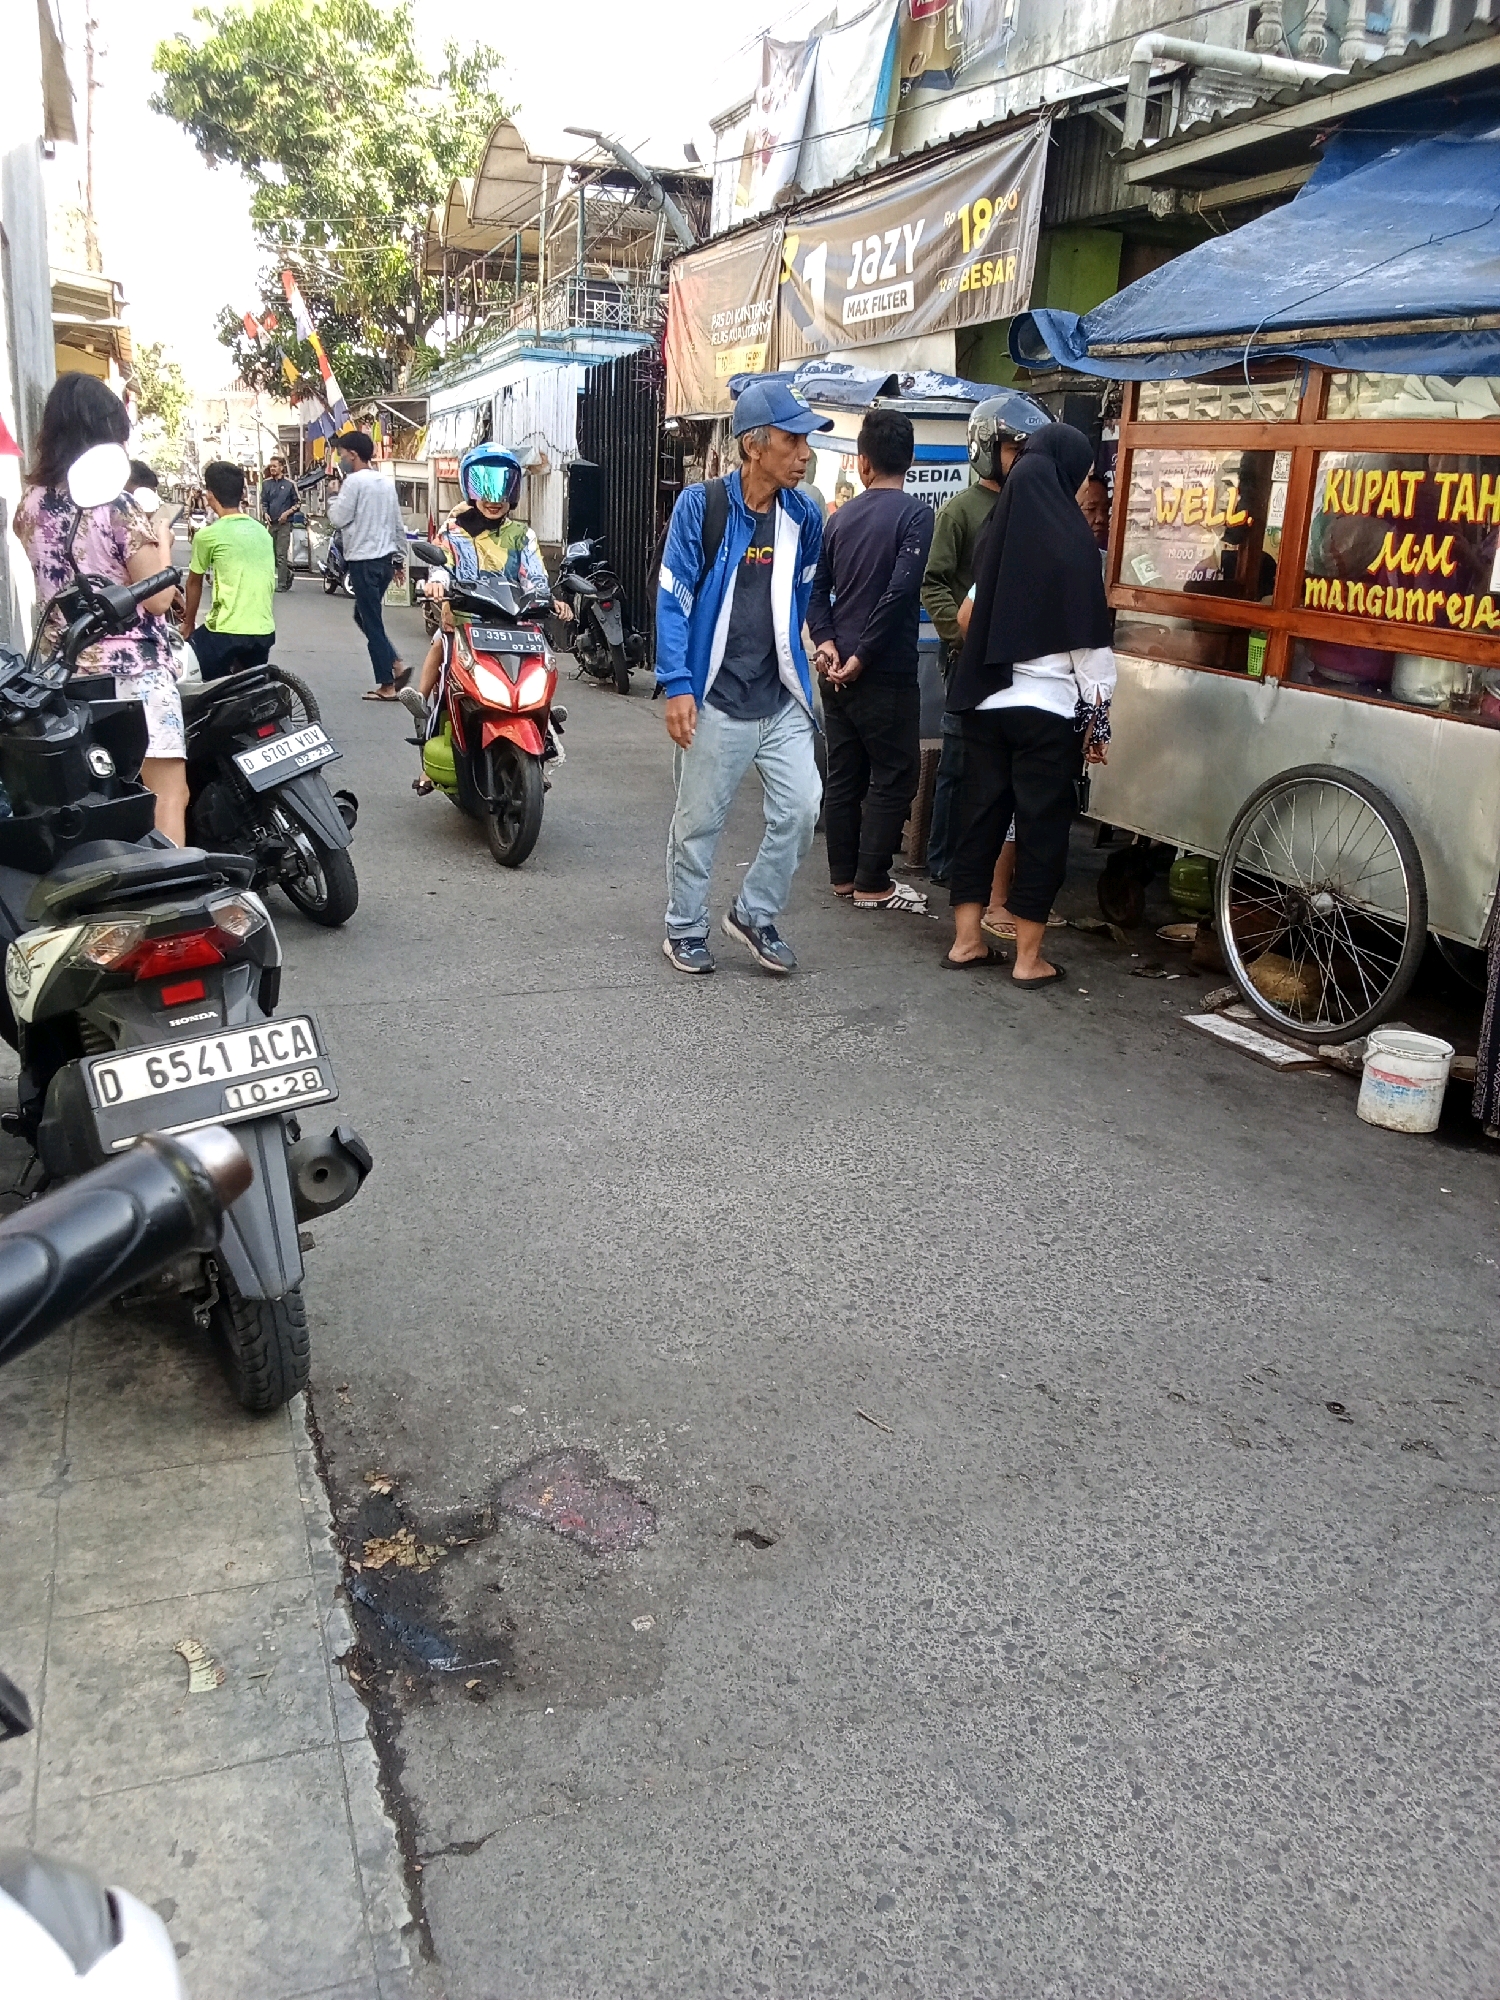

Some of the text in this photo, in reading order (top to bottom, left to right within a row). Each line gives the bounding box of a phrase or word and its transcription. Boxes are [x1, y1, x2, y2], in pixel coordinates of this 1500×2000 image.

[959, 256, 1016, 292] BESAR
[847, 289, 908, 319] MAX FILTER
[905, 468, 962, 483] SEDIA
[1323, 467, 1427, 519] KUPAT
[743, 546, 774, 564] FIC
[472, 629, 480, 638] D
[486, 630, 513, 641] 3351
[243, 758, 255, 771] D
[261, 741, 293, 763] 6707
[168, 1011, 219, 1027] HONDA
[99, 1024, 313, 1103] D 6541 ACA
